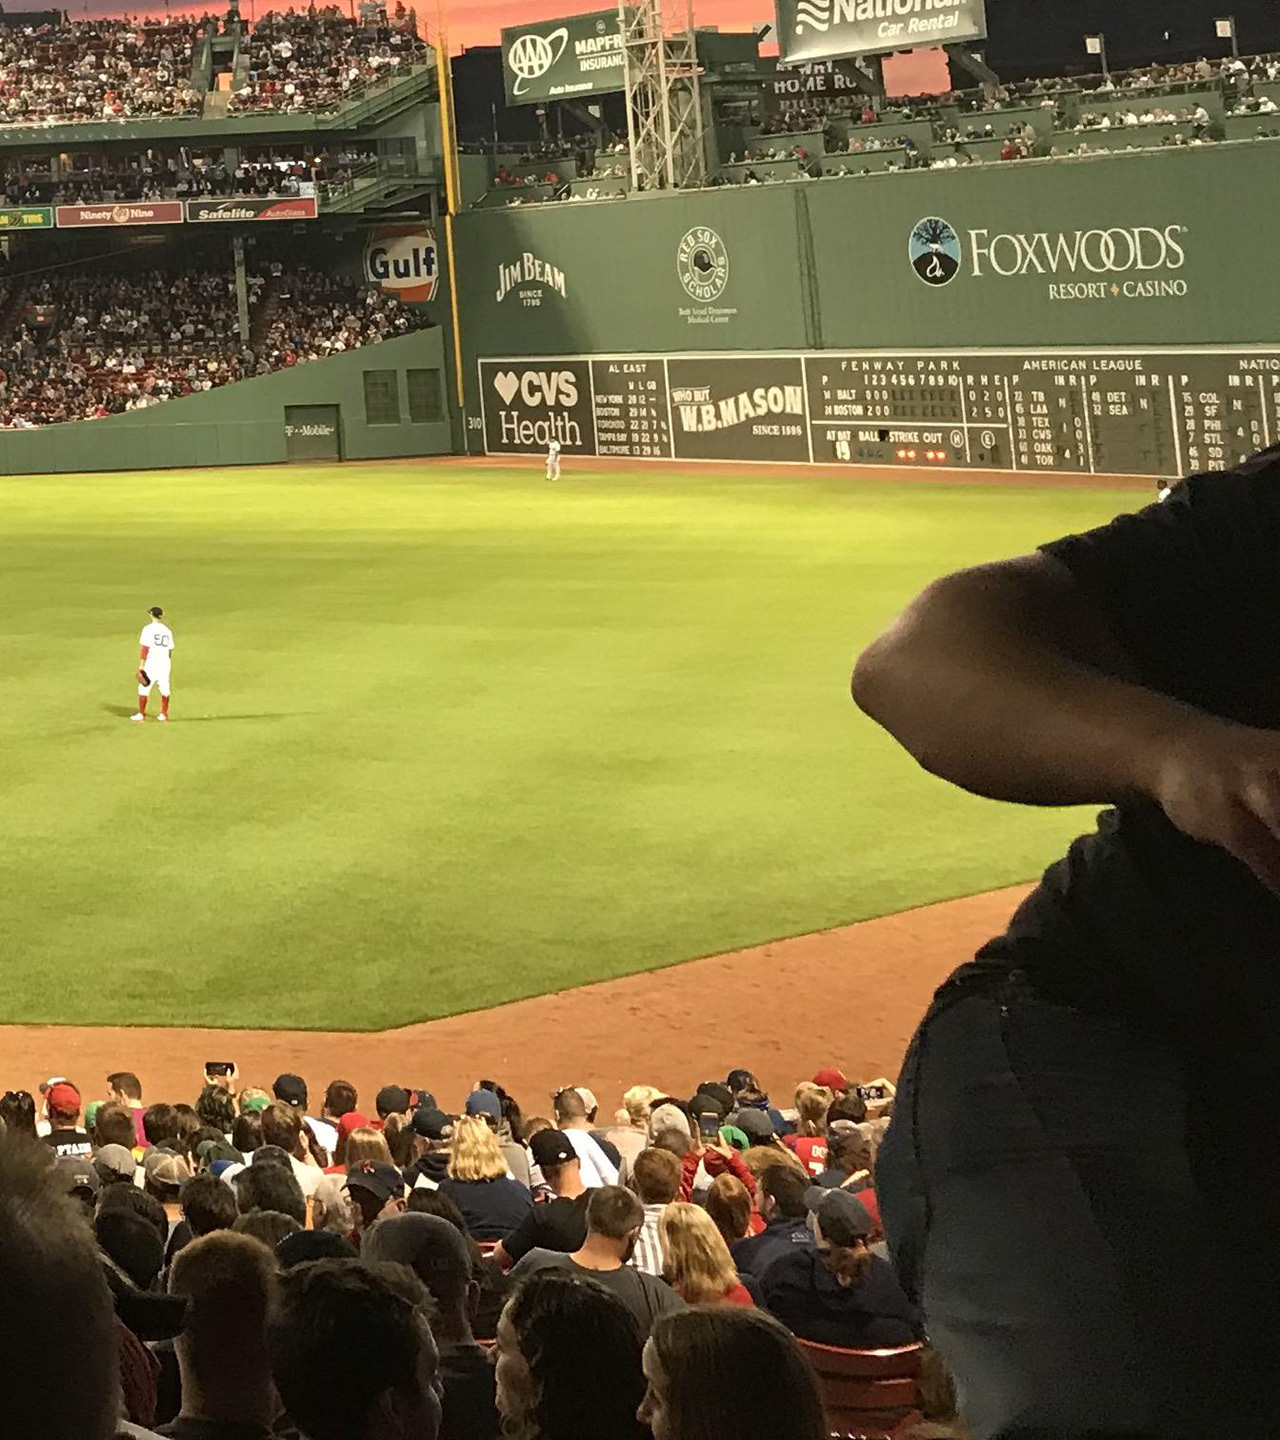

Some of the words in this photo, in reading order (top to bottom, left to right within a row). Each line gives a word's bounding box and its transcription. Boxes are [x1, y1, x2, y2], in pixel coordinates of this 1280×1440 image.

[878, 20, 904, 38] Car
[908, 11, 960, 33] Rental
[575, 34, 623, 56] MAPFR
[580, 54, 625, 72] INSURANC
[774, 76, 827, 94] HOME
[80, 210, 110, 220] Ninety
[130, 208, 154, 219] Nine
[198, 206, 255, 219] Safelite
[679, 235, 696, 262] RED
[697, 229, 718, 249] SOX
[967, 224, 1185, 277] FOXWOODS
[370, 246, 435, 279] Gulf
[496, 261, 521, 302] JIM
[523, 252, 568, 299] BEAM
[682, 256, 726, 299] SCHOLARS
[1048, 282, 1107, 300] RESORT
[1123, 279, 1187, 298] CASINO
[608, 364, 620, 373] AL
[623, 364, 647, 373] EAST
[841, 361, 905, 371] FENWAY
[917, 361, 961, 371] PARK
[1023, 360, 1087, 371] AMERICAN
[1093, 360, 1143, 370] LEAGUE
[822, 375, 828, 385] P
[864, 374, 869, 385] 1
[871, 374, 878, 385] 2
[880, 374, 887, 385] 3
[891, 374, 897, 385] 4
[899, 374, 906, 385] 5
[908, 374, 915, 385] 6
[919, 374, 926, 385] 7
[928, 374, 935, 385] 8
[937, 374, 944, 385] 9
[948, 374, 958, 385] 10
[967, 375, 974, 385] R
[981, 375, 988, 385] H
[994, 375, 1001, 385] E
[1013, 375, 1019, 385] P
[1054, 375, 1065, 385] IN
[1069, 375, 1077, 385] R
[1090, 375, 1097, 385] P
[1135, 375, 1146, 385] IN
[1151, 375, 1160, 385] R
[1181, 375, 1188, 386] P
[1228, 375, 1240, 386] IN
[1245, 375, 1254, 386] R
[520, 370, 579, 407] CVS
[638, 381, 644, 390] L
[672, 390, 692, 402] WHO
[693, 389, 710, 402] BUT
[836, 389, 856, 400] BALT
[1031, 391, 1044, 402] TB
[1107, 391, 1126, 402] DET
[1199, 392, 1220, 404] COL
[833, 404, 864, 416] BOSTON
[1030, 404, 1048, 415] LAA
[1108, 404, 1128, 415] SEA
[1204, 405, 1218, 417] SF
[468, 417, 482, 430] 310
[1032, 417, 1050, 427] TEX
[1204, 419, 1222, 430] PHI
[499, 410, 583, 447] Health
[752, 425, 781, 436] SINCE
[826, 430, 836, 441] AT
[838, 430, 851, 441] BAT
[888, 431, 919, 443] STRIKE
[923, 432, 943, 444] OUT
[1032, 429, 1052, 440] CWS
[1203, 433, 1224, 444] STL
[1034, 442, 1053, 453] OAK
[1208, 447, 1223, 458] SD
[1035, 455, 1054, 466] TOR
[1208, 460, 1225, 471] PIT
[154, 633, 170, 647] 50
